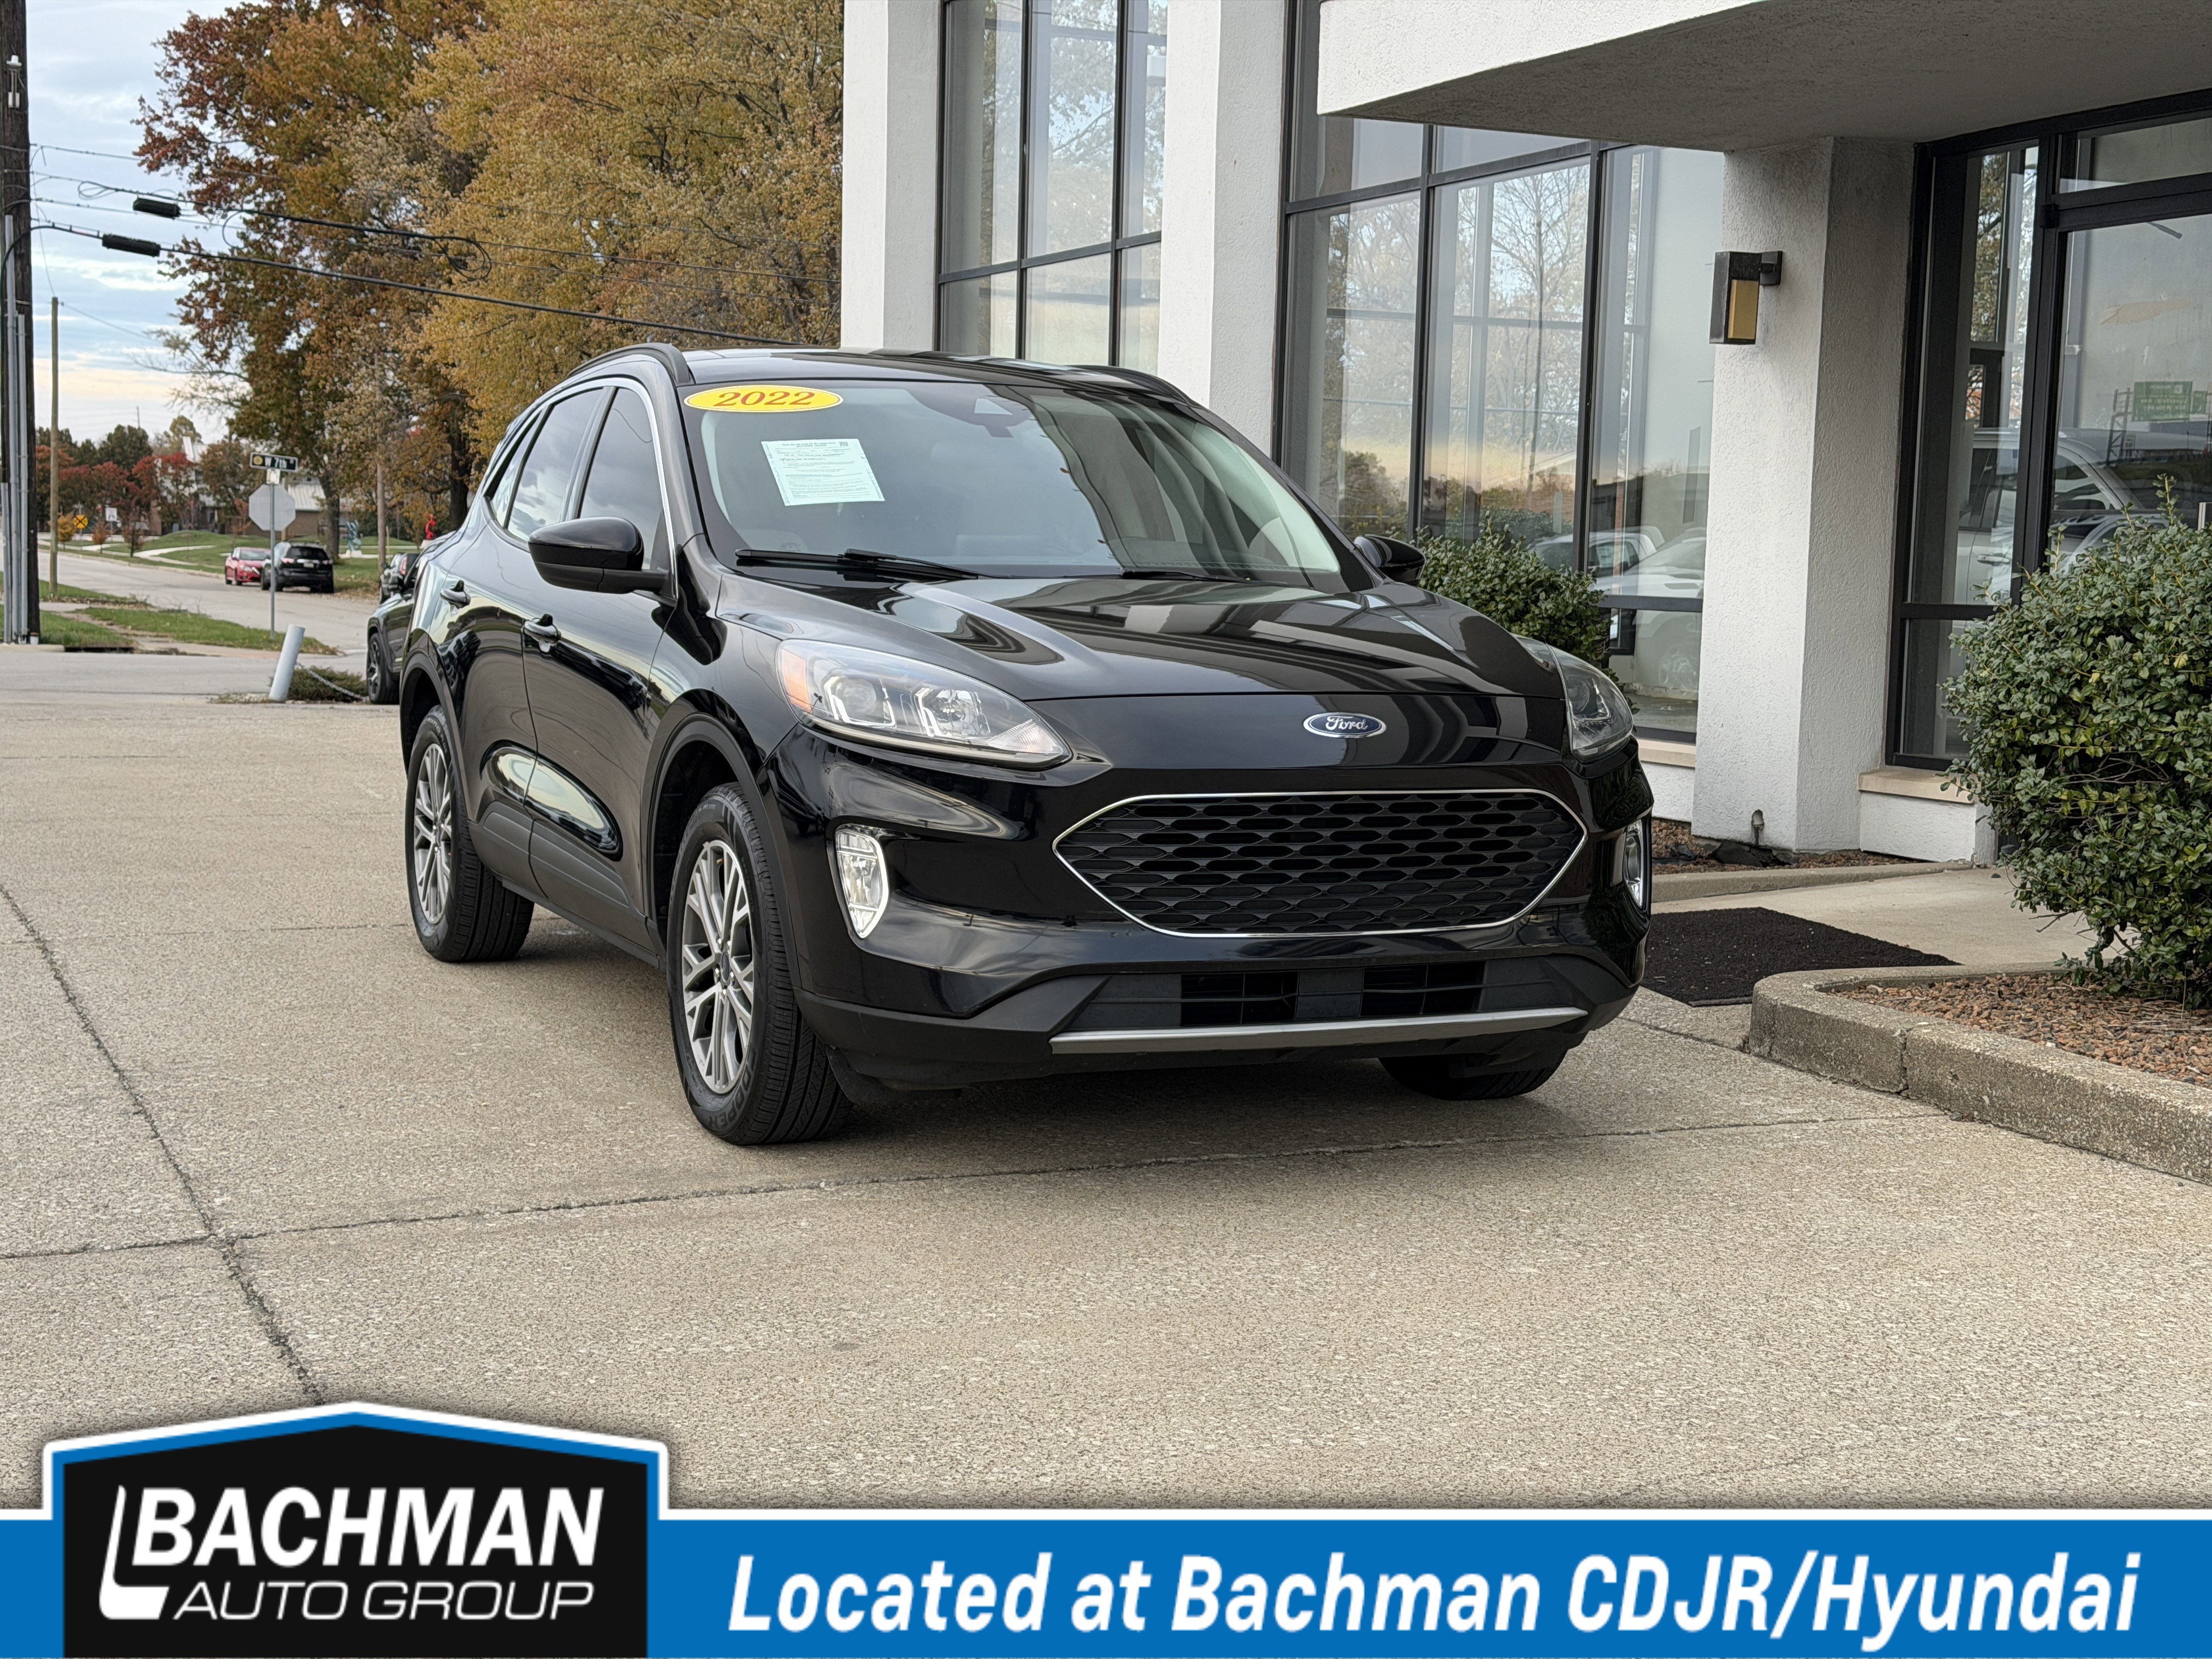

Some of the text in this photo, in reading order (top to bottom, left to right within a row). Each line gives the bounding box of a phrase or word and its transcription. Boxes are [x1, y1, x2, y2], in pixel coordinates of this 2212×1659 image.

[713, 391, 815, 407] 2022
[264, 456, 272, 467] W
[274, 456, 287, 468] 7th
[1325, 715, 1368, 730] Ford
